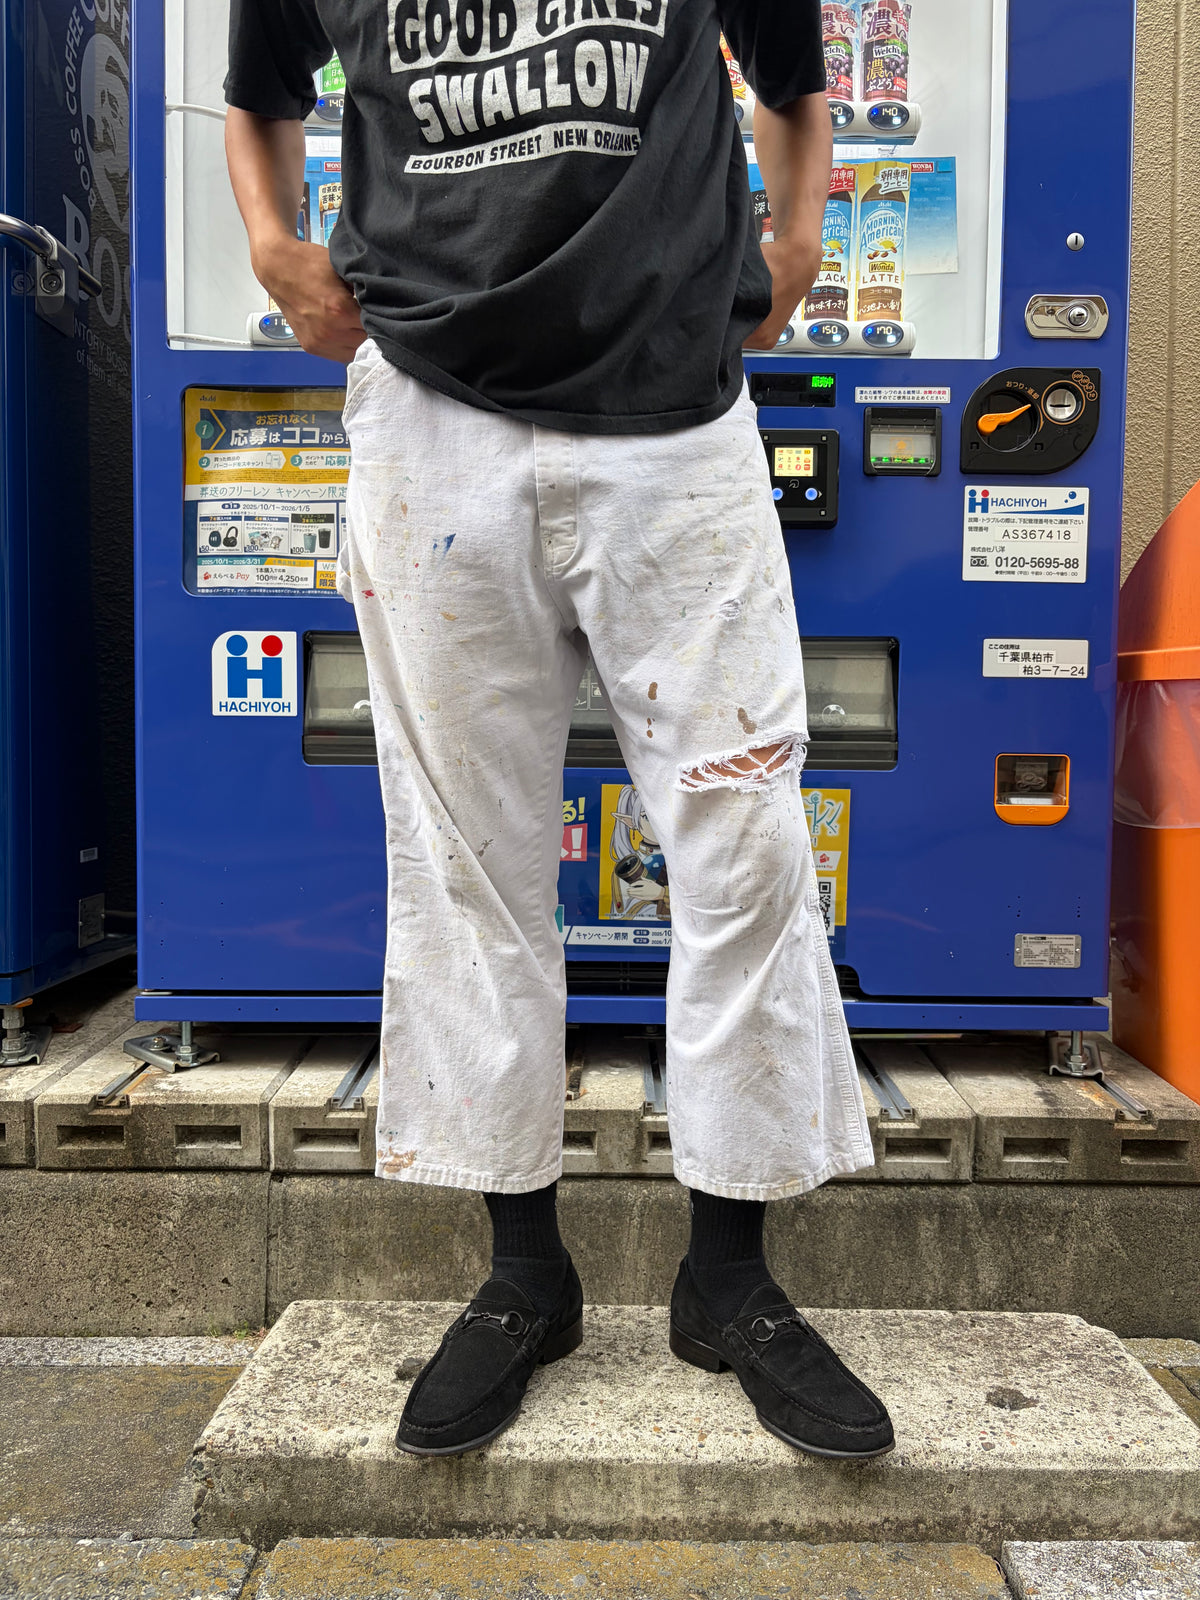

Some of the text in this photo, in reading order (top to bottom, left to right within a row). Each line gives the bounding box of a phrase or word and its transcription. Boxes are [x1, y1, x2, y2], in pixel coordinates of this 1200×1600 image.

[866, 8, 907, 39] 濃い
[394, 0, 517, 64] GOOD
[824, 45, 846, 56] elch's
[65, 6, 84, 116] COFFEE
[866, 58, 894, 81] 濃い
[408, 39, 650, 143] SWALLOW
[866, 79, 893, 92] ぶどう
[329, 99, 344, 107] 140
[829, 107, 843, 116] 40
[882, 107, 898, 116] 140
[410, 129, 641, 171] BOURBON STREET NEW ORLEANS
[880, 168, 908, 181] 朝専用
[866, 215, 900, 234] MORNING
[871, 262, 894, 272] Wonda
[817, 273, 847, 285] LACK
[862, 273, 900, 285] LATTE
[806, 299, 847, 314] 後味すっきり
[858, 299, 900, 315] 心地よい香り
[822, 325, 838, 335] 150
[876, 326, 893, 335] 170
[811, 376, 834, 388] 販売中
[255, 414, 316, 426] お忘れなく!
[229, 427, 350, 447] 応募はココから!
[200, 486, 270, 498] 葬送のフリーレン
[990, 497, 1047, 508] HACHIYOH
[1002, 529, 1072, 541] AS367418
[995, 556, 1080, 569] 0120-5695-88
[998, 651, 1054, 663] 千葉県柏市
[218, 701, 291, 713] HACHIYOH
[575, 931, 628, 941] キャンペーン期間
